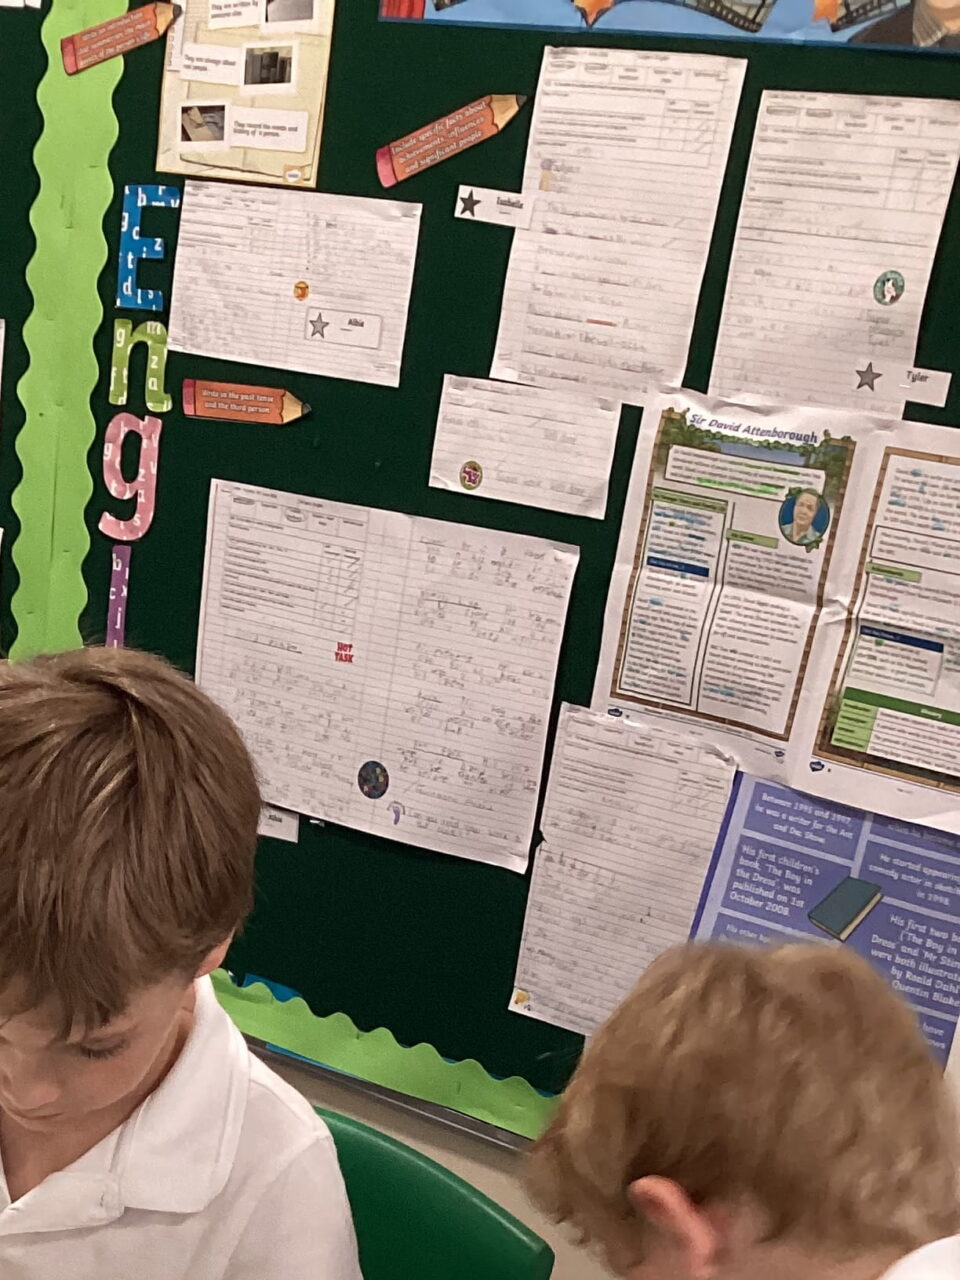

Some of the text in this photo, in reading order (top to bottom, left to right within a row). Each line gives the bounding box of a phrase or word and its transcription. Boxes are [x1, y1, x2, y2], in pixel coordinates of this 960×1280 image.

[391, 102, 486, 155] Include specific facts about
[405, 162, 419, 173] and
[420, 142, 457, 165] significant
[906, 370, 929, 383] Tyler
[240, 393, 255, 401] past
[230, 403, 247, 411] third
[690, 413, 818, 445] Sir David Attenborough
[337, 641, 353, 653] HOT
[334, 651, 354, 664] TASK
[762, 792, 831, 819] Between 1995 and
[766, 809, 781, 818] was
[788, 815, 812, 826] writer
[812, 820, 825, 831] for
[825, 823, 838, 835] the
[839, 828, 854, 840] Ant
[773, 823, 803, 837] and Dec
[757, 848, 776, 863] first
[778, 856, 820, 876] children's
[880, 852, 891, 863] He
[892, 858, 921, 872] started
[736, 868, 750, 879] the
[783, 883, 801, 895] was
[784, 870, 802, 885] Boy
[803, 876, 813, 886] in
[868, 864, 899, 880] comedy
[729, 891, 764, 908] October
[732, 881, 805, 909] published on 1st
[916, 889, 926, 899] in
[906, 919, 927, 934] first
[929, 926, 949, 940] two
[900, 944, 920, 957] and
[925, 937, 945, 954] Boy
[947, 944, 958, 956] in
[870, 949, 893, 962] were
[894, 953, 917, 969] both
[890, 965, 933, 987] by Roald
[891, 979, 930, 999] Quentin
[923, 1021, 945, 1037] have
